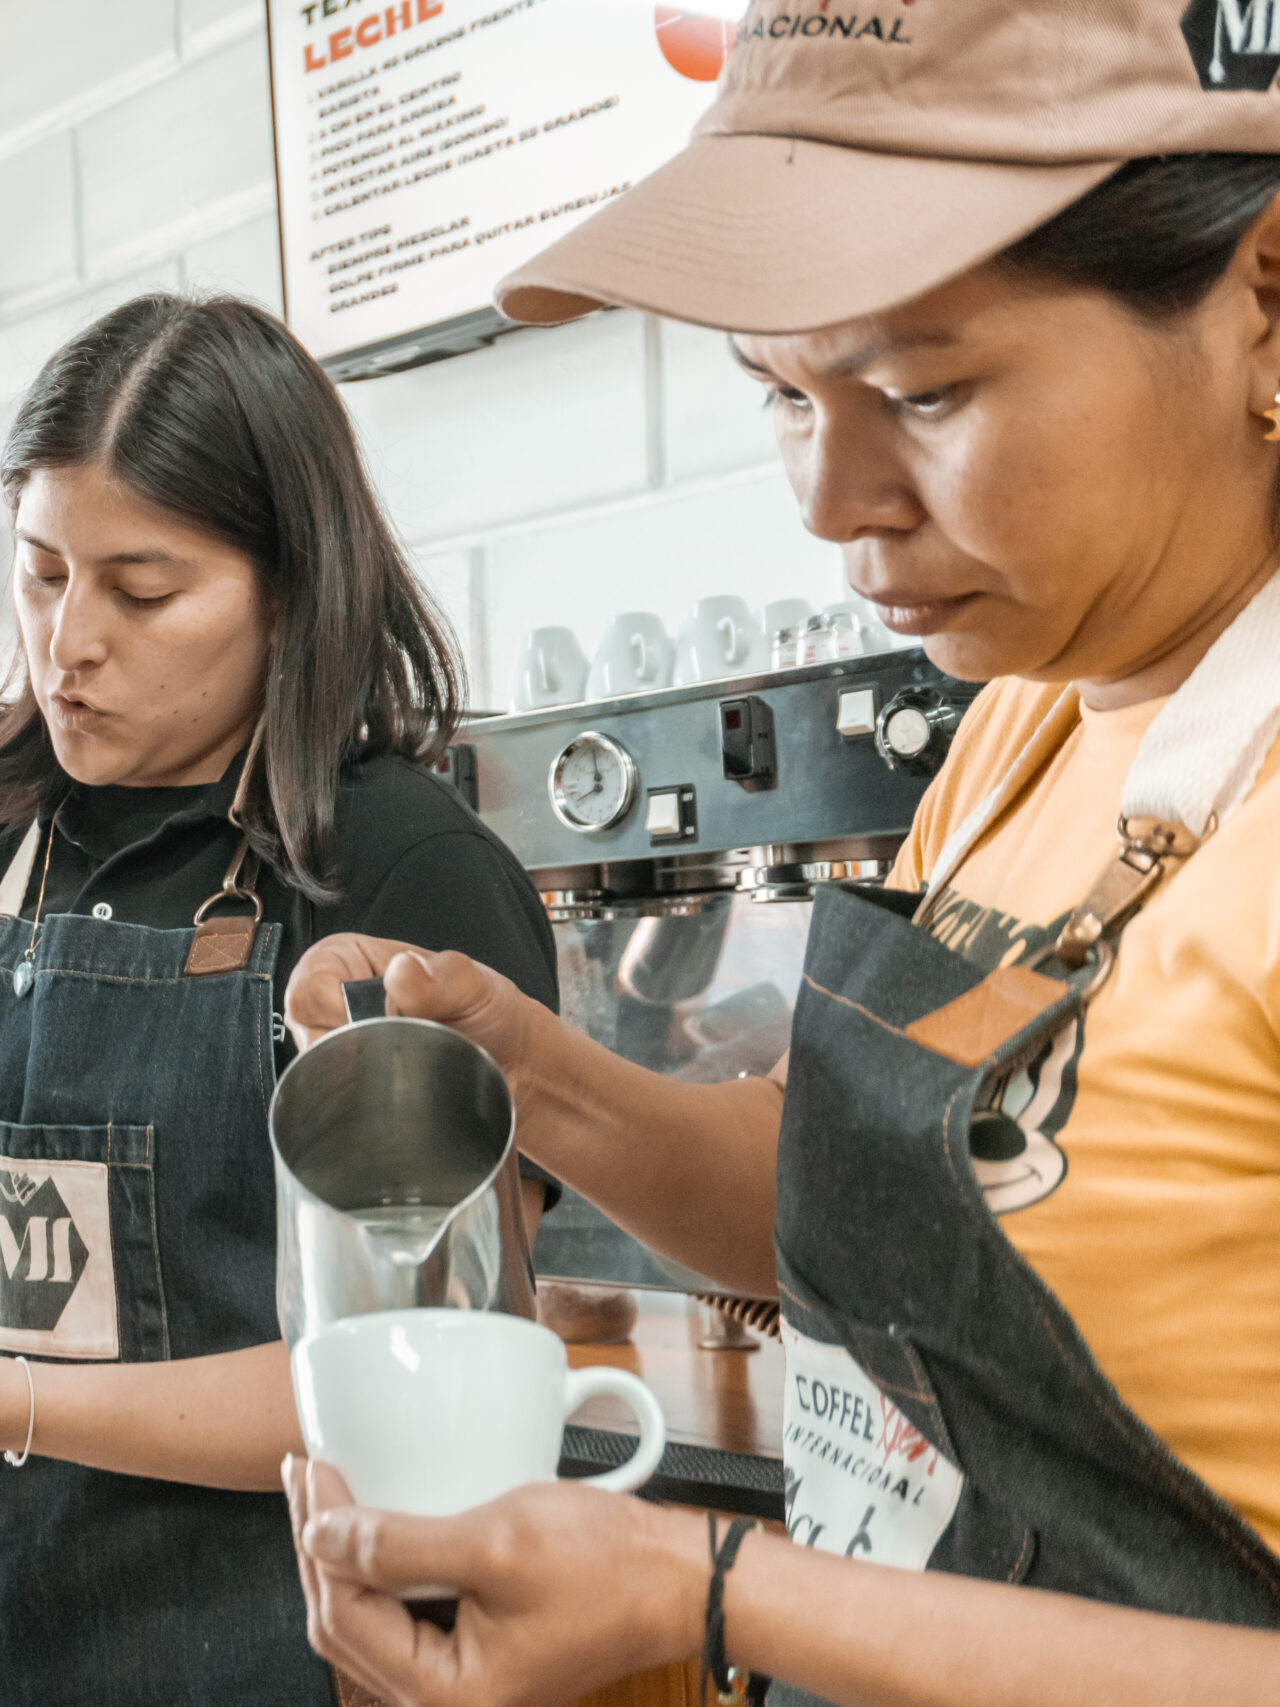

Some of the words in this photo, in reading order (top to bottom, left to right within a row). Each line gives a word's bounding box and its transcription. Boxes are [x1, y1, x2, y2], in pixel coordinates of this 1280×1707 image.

[303, 0, 445, 74] LECHE
[399, 72, 461, 105] CENTRO
[356, 120, 397, 143] PARA
[322, 142, 394, 177] POTENCIA
[400, 146, 435, 167] AIRE
[324, 180, 402, 216] CALENTAR
[404, 160, 453, 186] LECHE
[309, 237, 356, 262] AFTER
[429, 238, 471, 260] PARA
[474, 216, 535, 245] QUITAR
[327, 244, 394, 275] SIEMPRE
[330, 282, 399, 314] GRANDES
[795, 1373, 874, 1442] COFFEE
[784, 1421, 925, 1506] INTERNACIONAL
